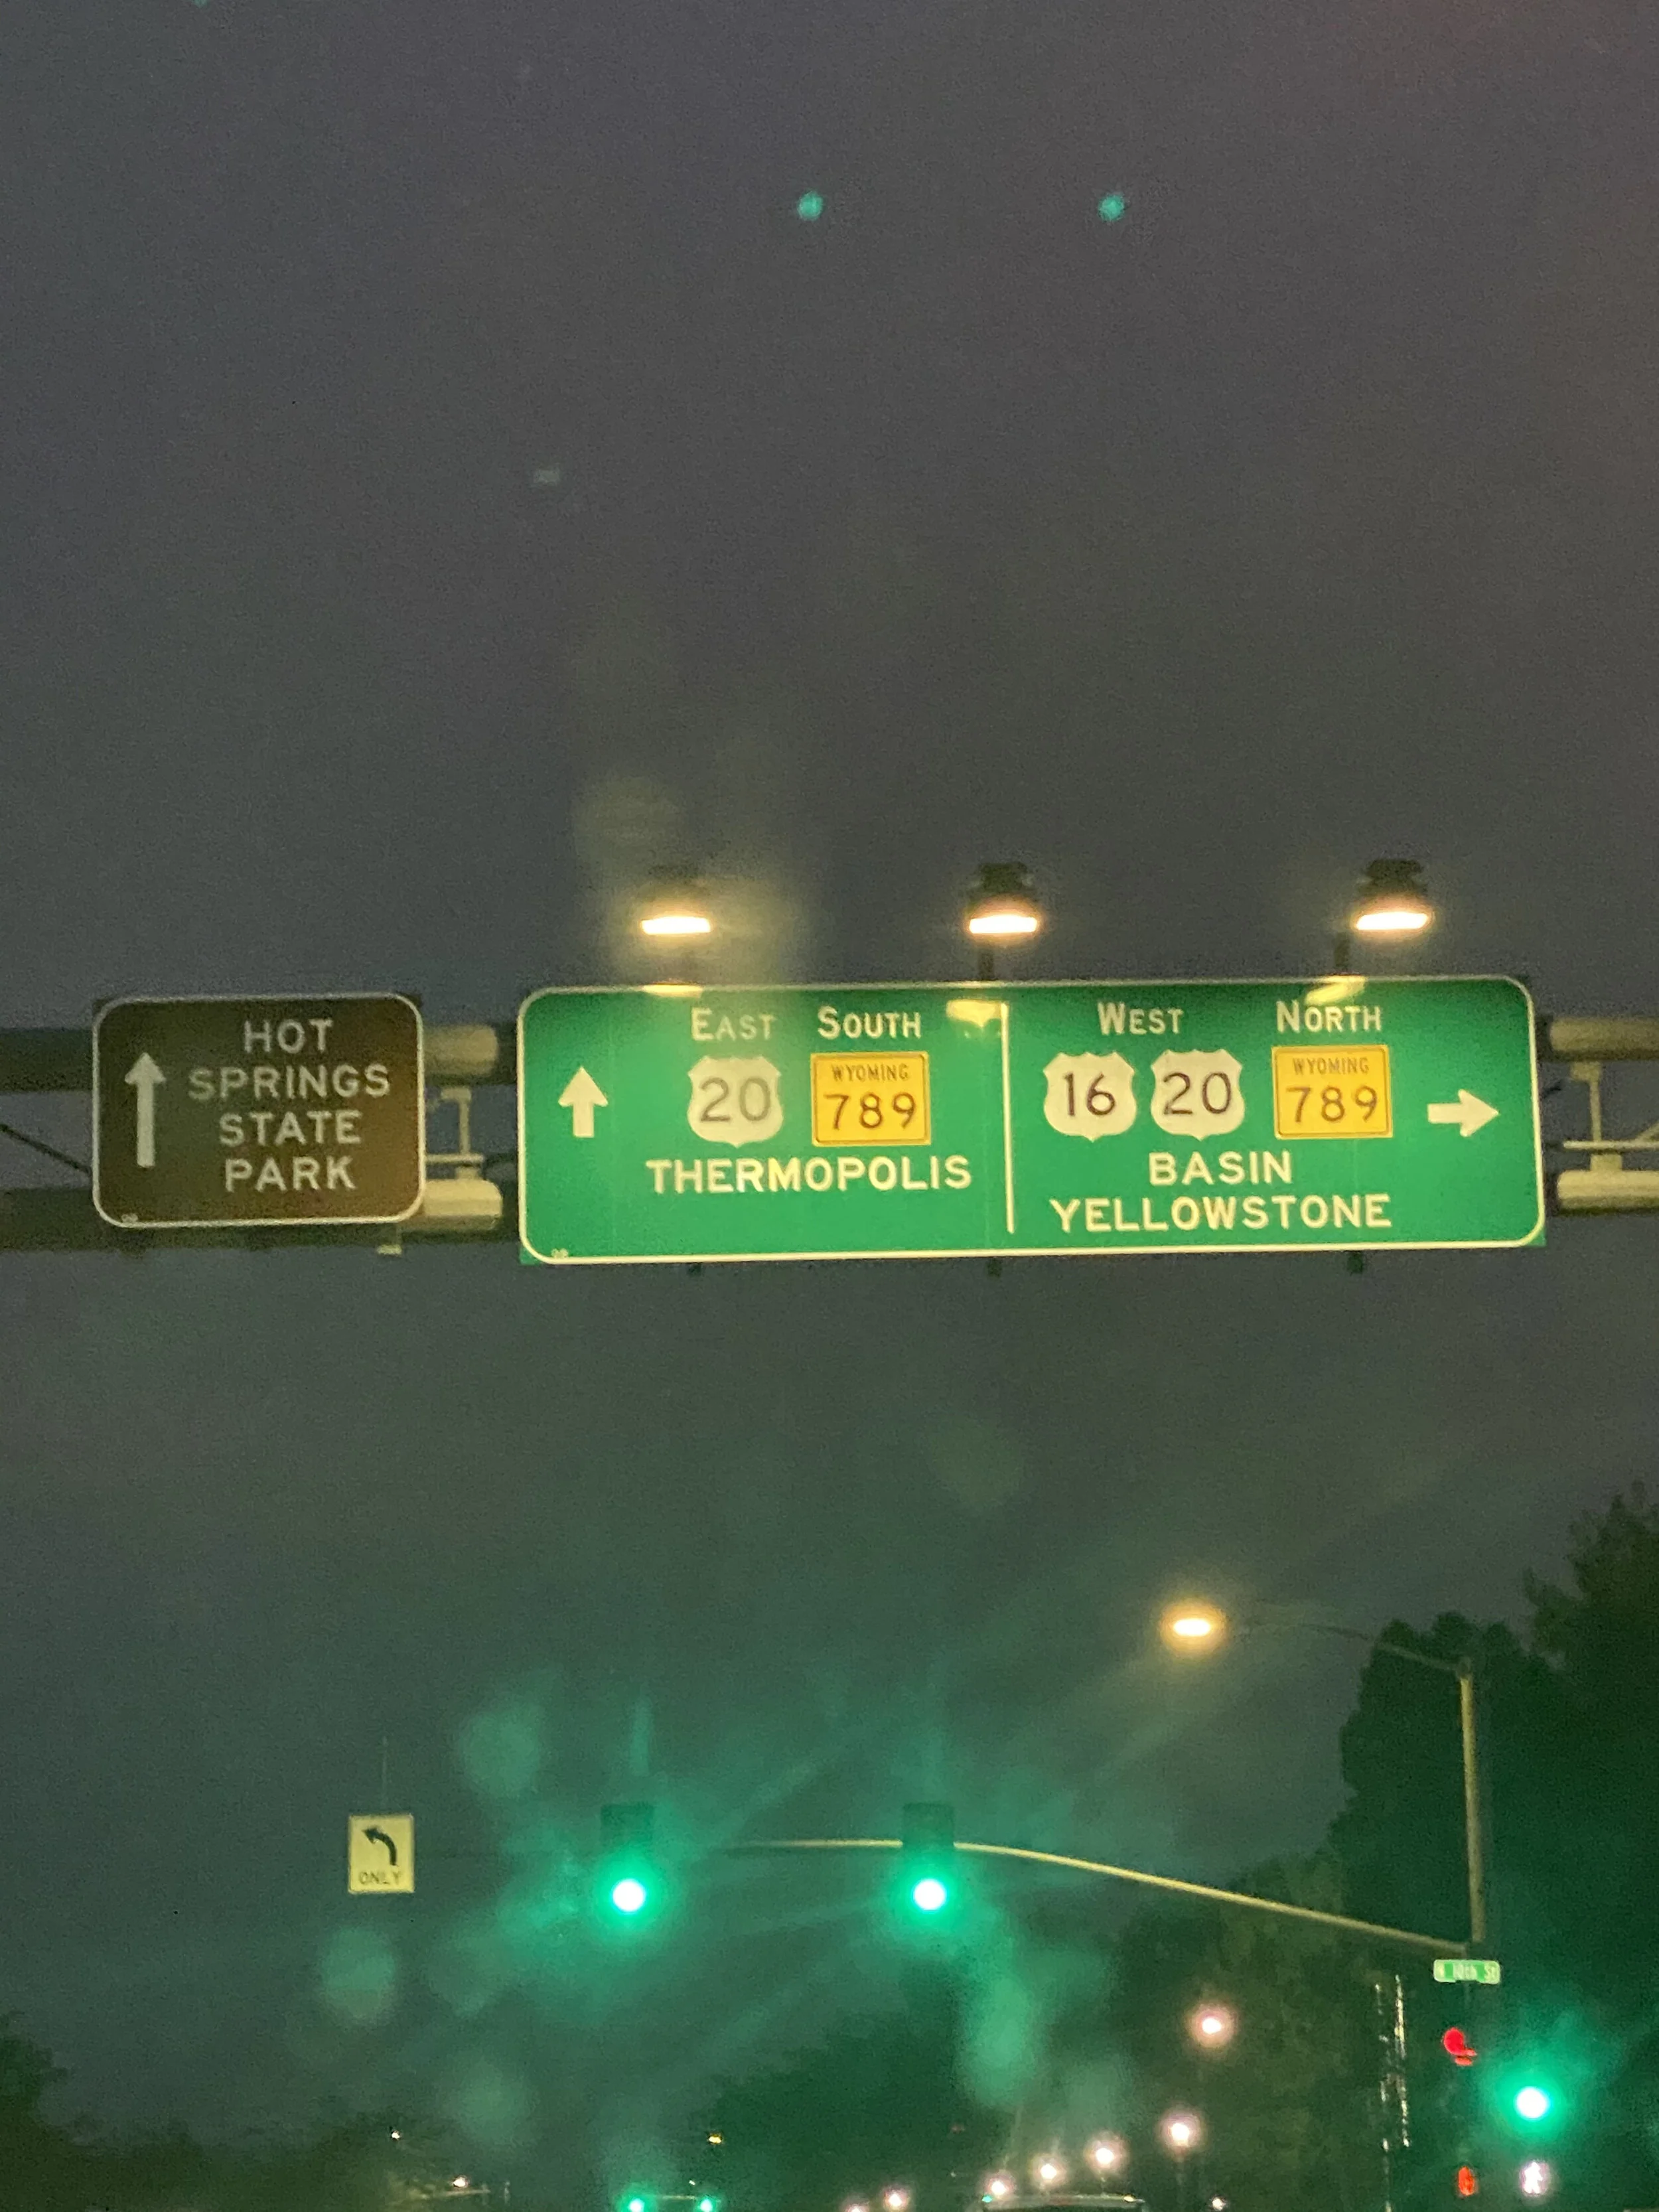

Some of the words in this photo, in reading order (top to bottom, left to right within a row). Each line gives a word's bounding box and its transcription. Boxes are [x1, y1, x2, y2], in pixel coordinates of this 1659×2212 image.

[691, 1007, 775, 1041] EAST
[817, 1005, 922, 1040] SOUTH
[1098, 1001, 1184, 1035] WEST
[1275, 999, 1382, 1033] NORTH
[243, 1017, 333, 1055] HOT
[188, 1063, 392, 1100] SPRINGS
[831, 1063, 909, 1082] WYOMING
[1293, 1057, 1370, 1075] WYOMING
[699, 1076, 772, 1123] 20
[823, 1091, 917, 1130] 789
[1064, 1072, 1116, 1116] 16
[1163, 1072, 1232, 1115] 20
[1285, 1085, 1378, 1123] 789
[219, 1110, 362, 1147] STATE
[224, 1155, 356, 1192] PARK
[646, 1155, 972, 1194] THERMOPOLIS
[1149, 1150, 1293, 1186] BASIN
[1049, 1193, 1392, 1233] YELLOWSTONE
